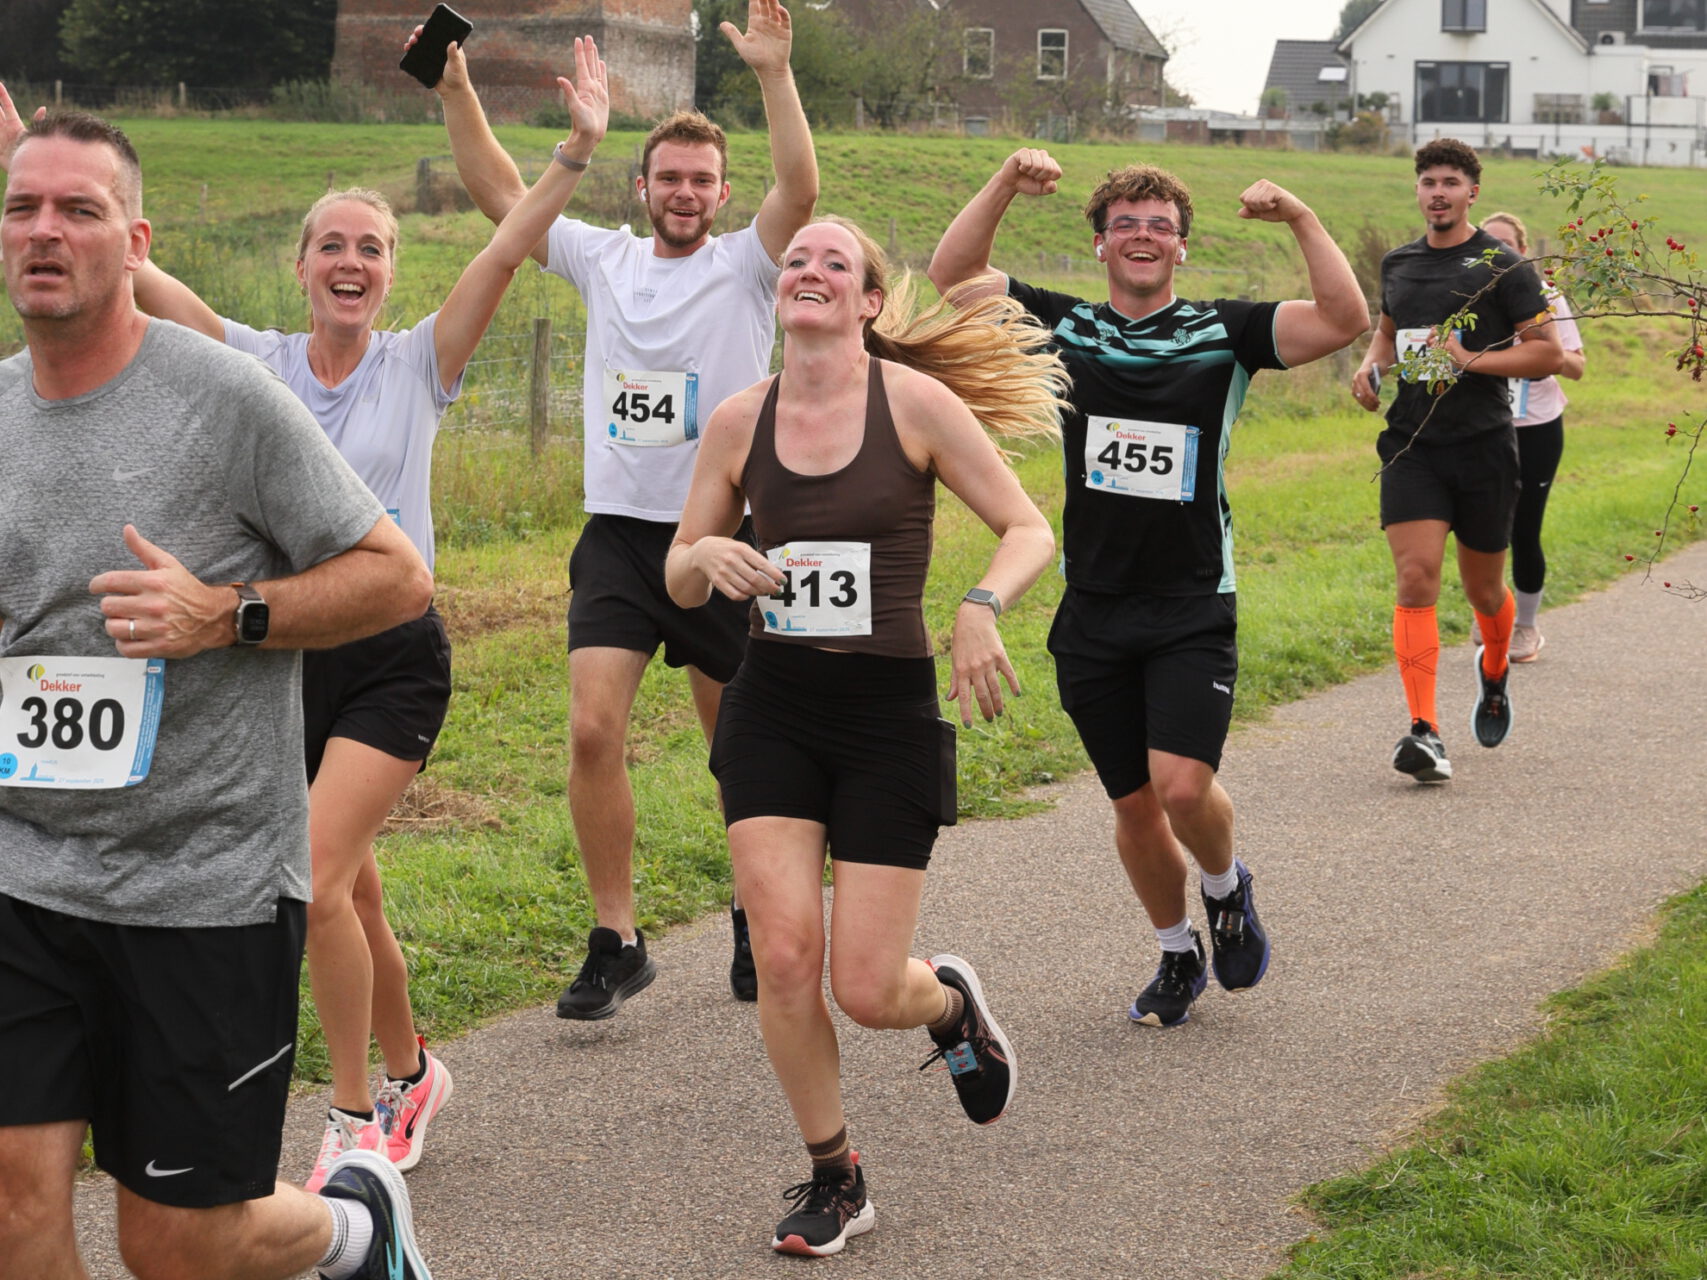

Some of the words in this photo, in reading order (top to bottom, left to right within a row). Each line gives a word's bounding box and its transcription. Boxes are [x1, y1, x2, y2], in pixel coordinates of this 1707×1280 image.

[623, 382, 648, 391] Dekker
[612, 391, 675, 424] 454
[1116, 431, 1146, 441] Dekker
[1097, 440, 1173, 476] 455
[785, 557, 823, 568] Dekker
[769, 570, 858, 608] 413
[40, 679, 82, 693] Dekker
[16, 696, 125, 751] 380
